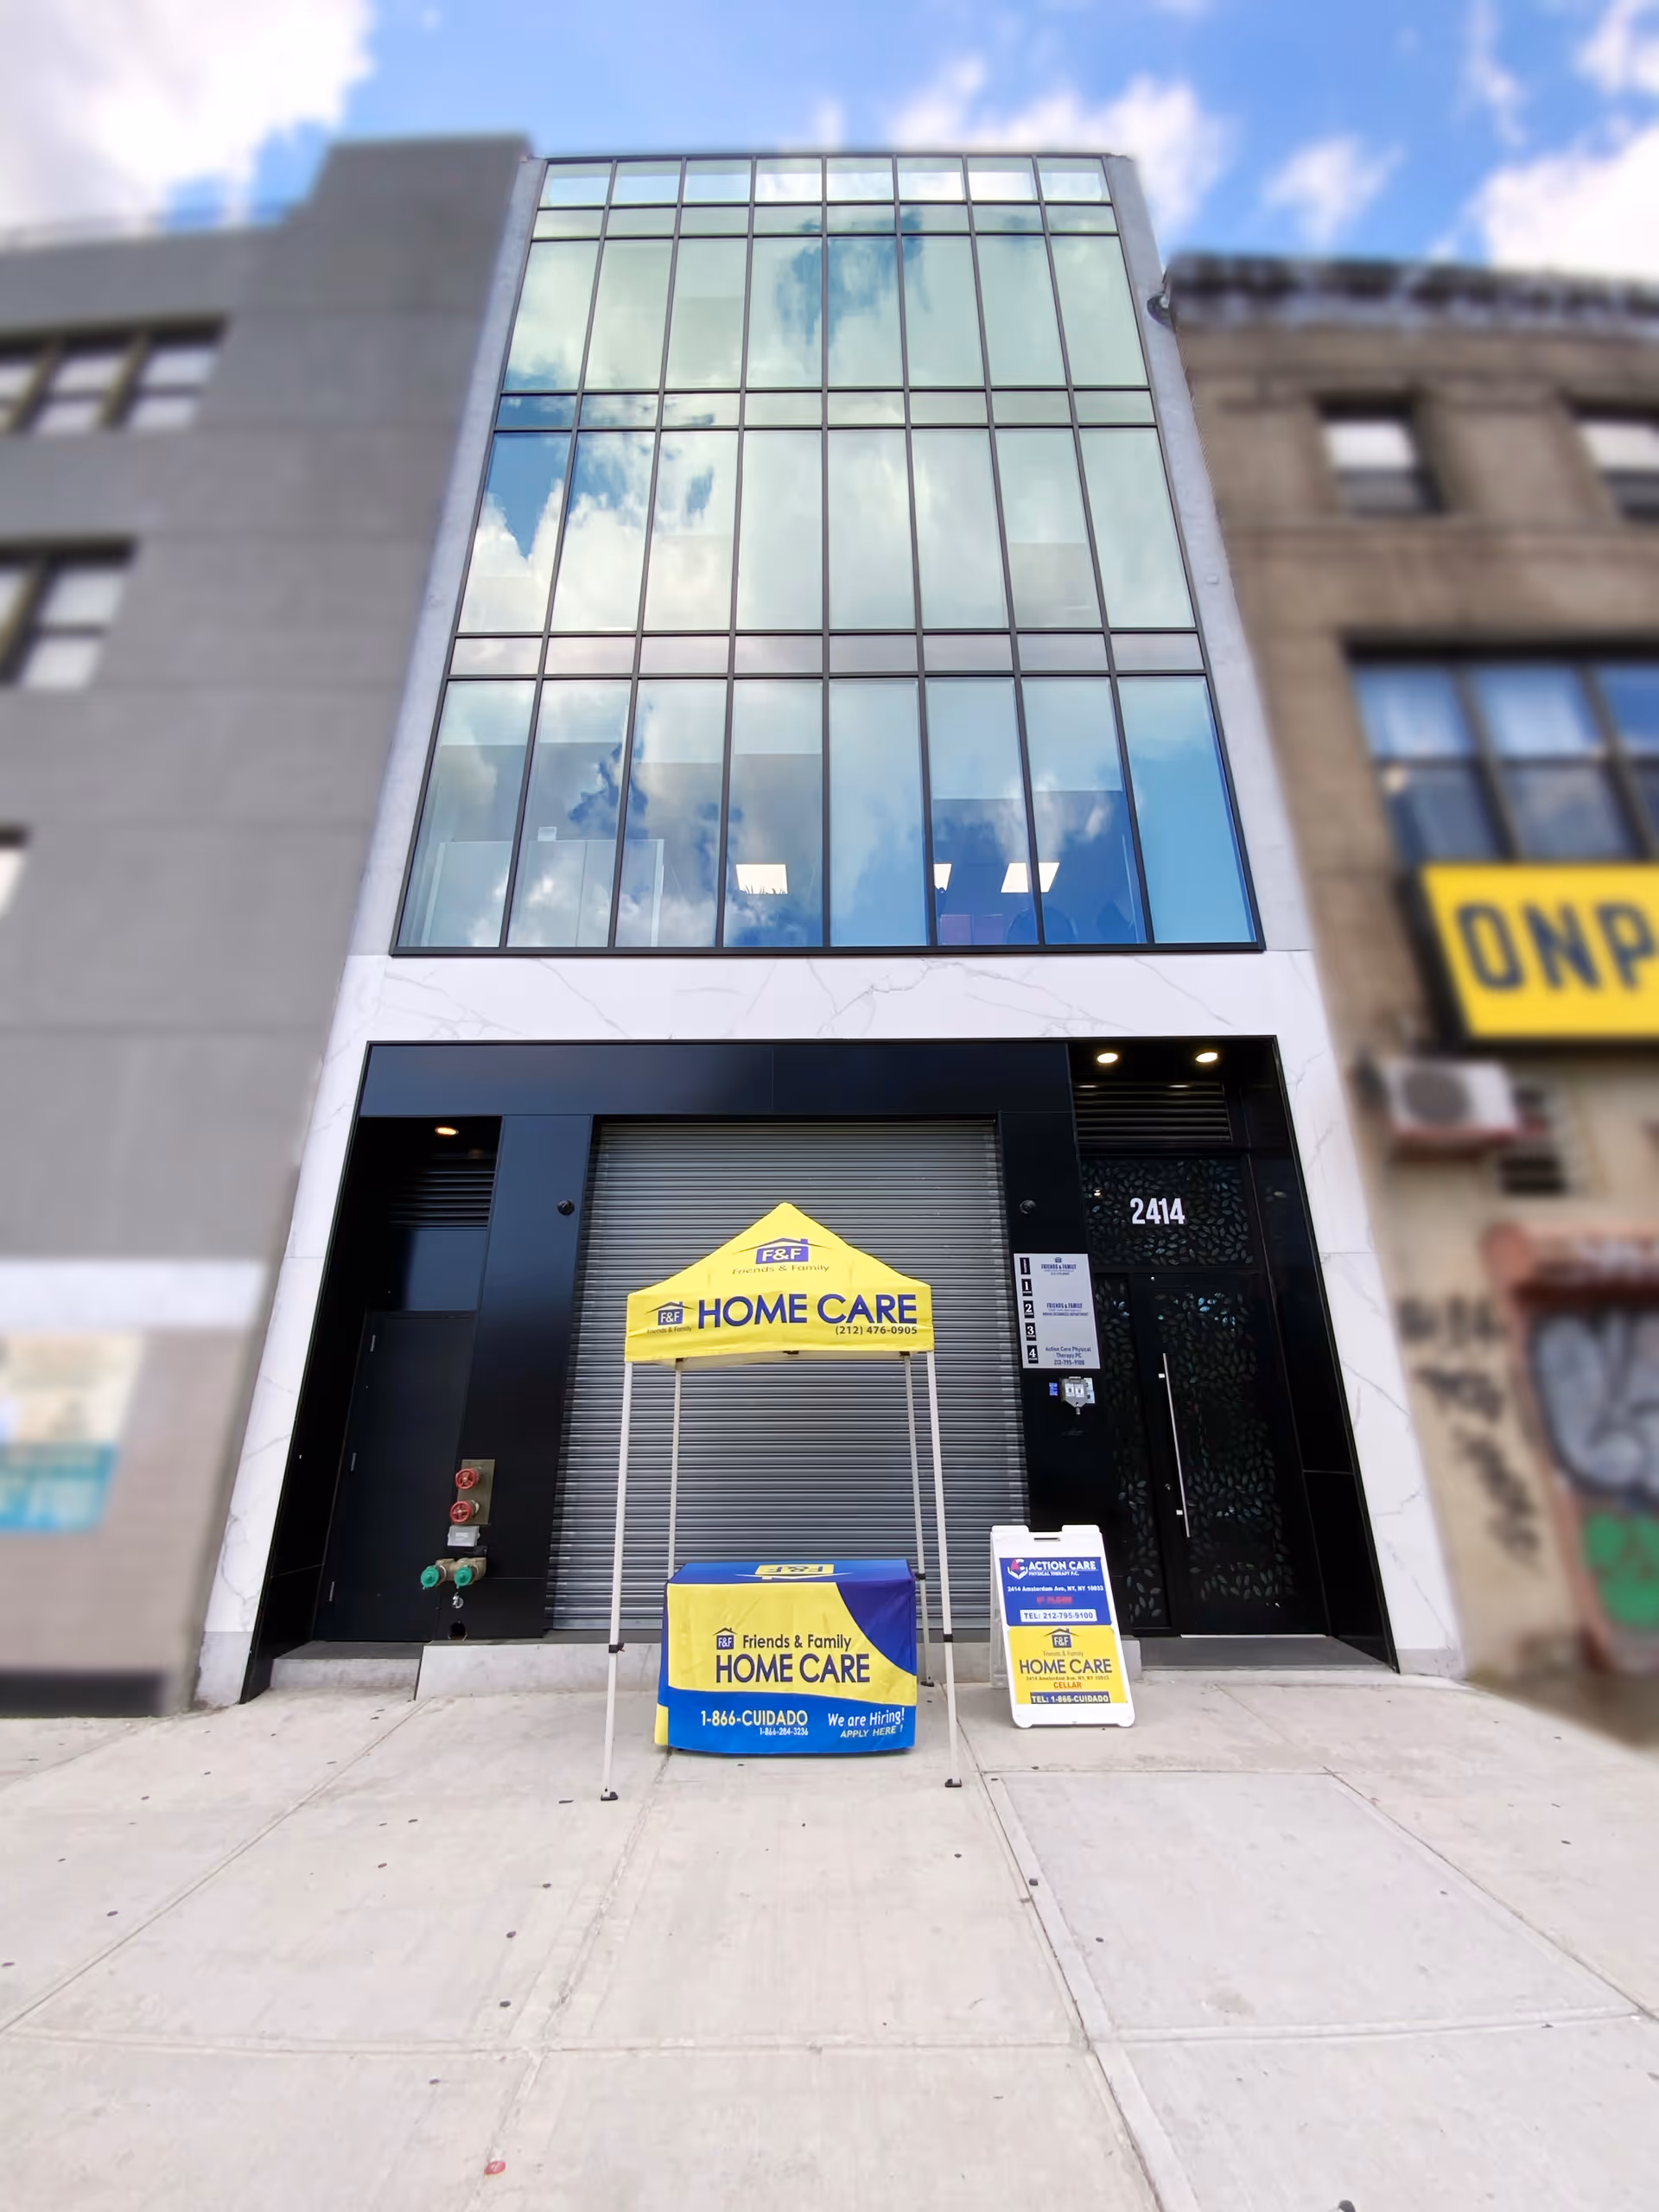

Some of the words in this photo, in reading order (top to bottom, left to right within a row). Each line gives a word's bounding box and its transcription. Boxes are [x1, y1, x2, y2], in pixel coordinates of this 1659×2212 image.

[1454, 902, 1659, 991] ONP
[1129, 1198, 1185, 1224] 2414
[761, 1248, 803, 1262] F&F
[732, 1266, 775, 1274] Friends
[1025, 1281, 1029, 1291] 1
[698, 1294, 808, 1329] HOME
[817, 1294, 918, 1324] CARE
[1025, 1303, 1033, 1313] 2
[660, 1311, 680, 1324] F&F
[836, 1325, 863, 1335] (212)
[866, 1325, 918, 1335] 476-0905
[1027, 1325, 1034, 1335] 3
[1028, 1348, 1037, 1358] 4
[1028, 1560, 1067, 1571] ACTION
[1069, 1560, 1096, 1570] CARE
[718, 1637, 733, 1648] F&F
[742, 1634, 790, 1649] Friends
[794, 1635, 803, 1648] &
[808, 1634, 852, 1652] Family
[1054, 1637, 1069, 1646] F&F
[715, 1653, 793, 1683] HOME
[799, 1653, 870, 1683] CARE
[1020, 1659, 1066, 1674] HOME
[1069, 1658, 1112, 1674] CARE
[1051, 1694, 1109, 1703] 1-866-CUIDADO
[700, 1709, 809, 1726] 1-866-CUIDADO
[828, 1713, 844, 1726] We
[847, 1714, 866, 1726] are
[869, 1707, 906, 1726] Hiring!
[760, 1726, 809, 1736] 1-866-284-3236
[839, 1729, 869, 1738] APPLY
[872, 1726, 897, 1737] HERE
